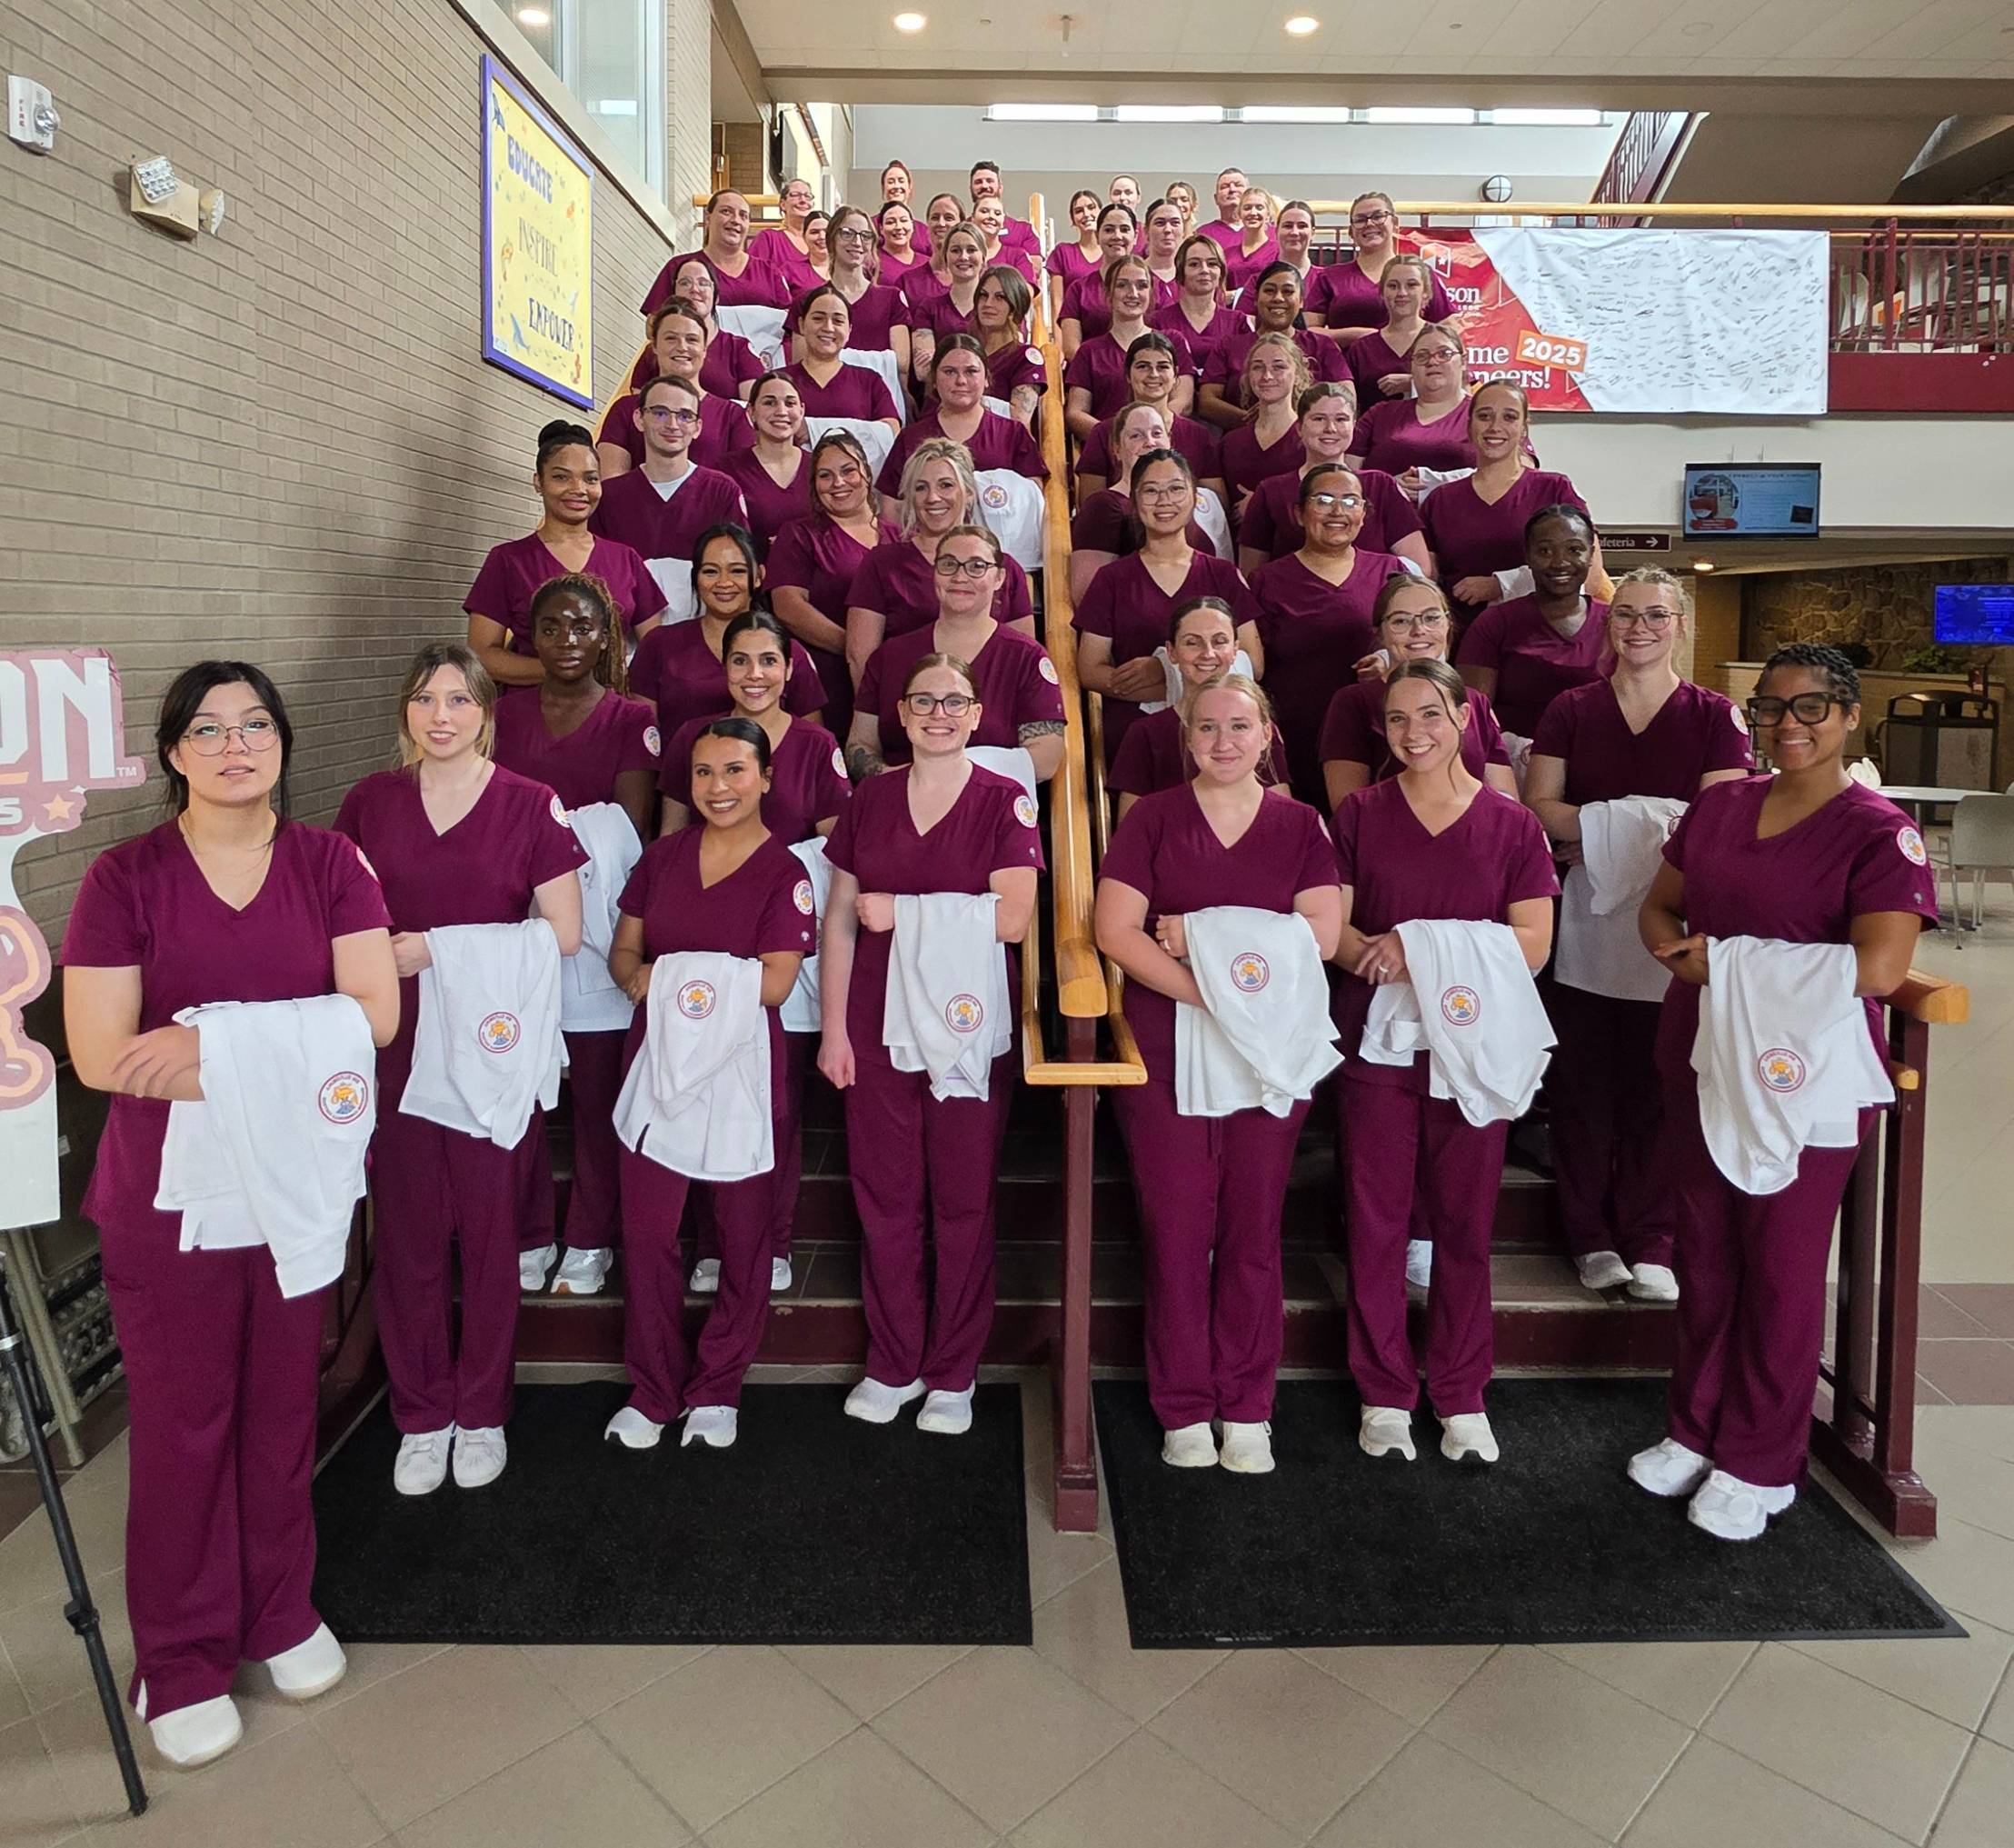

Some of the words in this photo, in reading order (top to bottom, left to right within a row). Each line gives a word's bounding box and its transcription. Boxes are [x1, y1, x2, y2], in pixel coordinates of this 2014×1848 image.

[507, 134, 553, 204] EDUCATE
[519, 216, 558, 277] INSPIRE
[528, 297, 574, 353] EMPOWER
[1521, 337, 1581, 365] 2025
[1470, 365, 1550, 389] neers!
